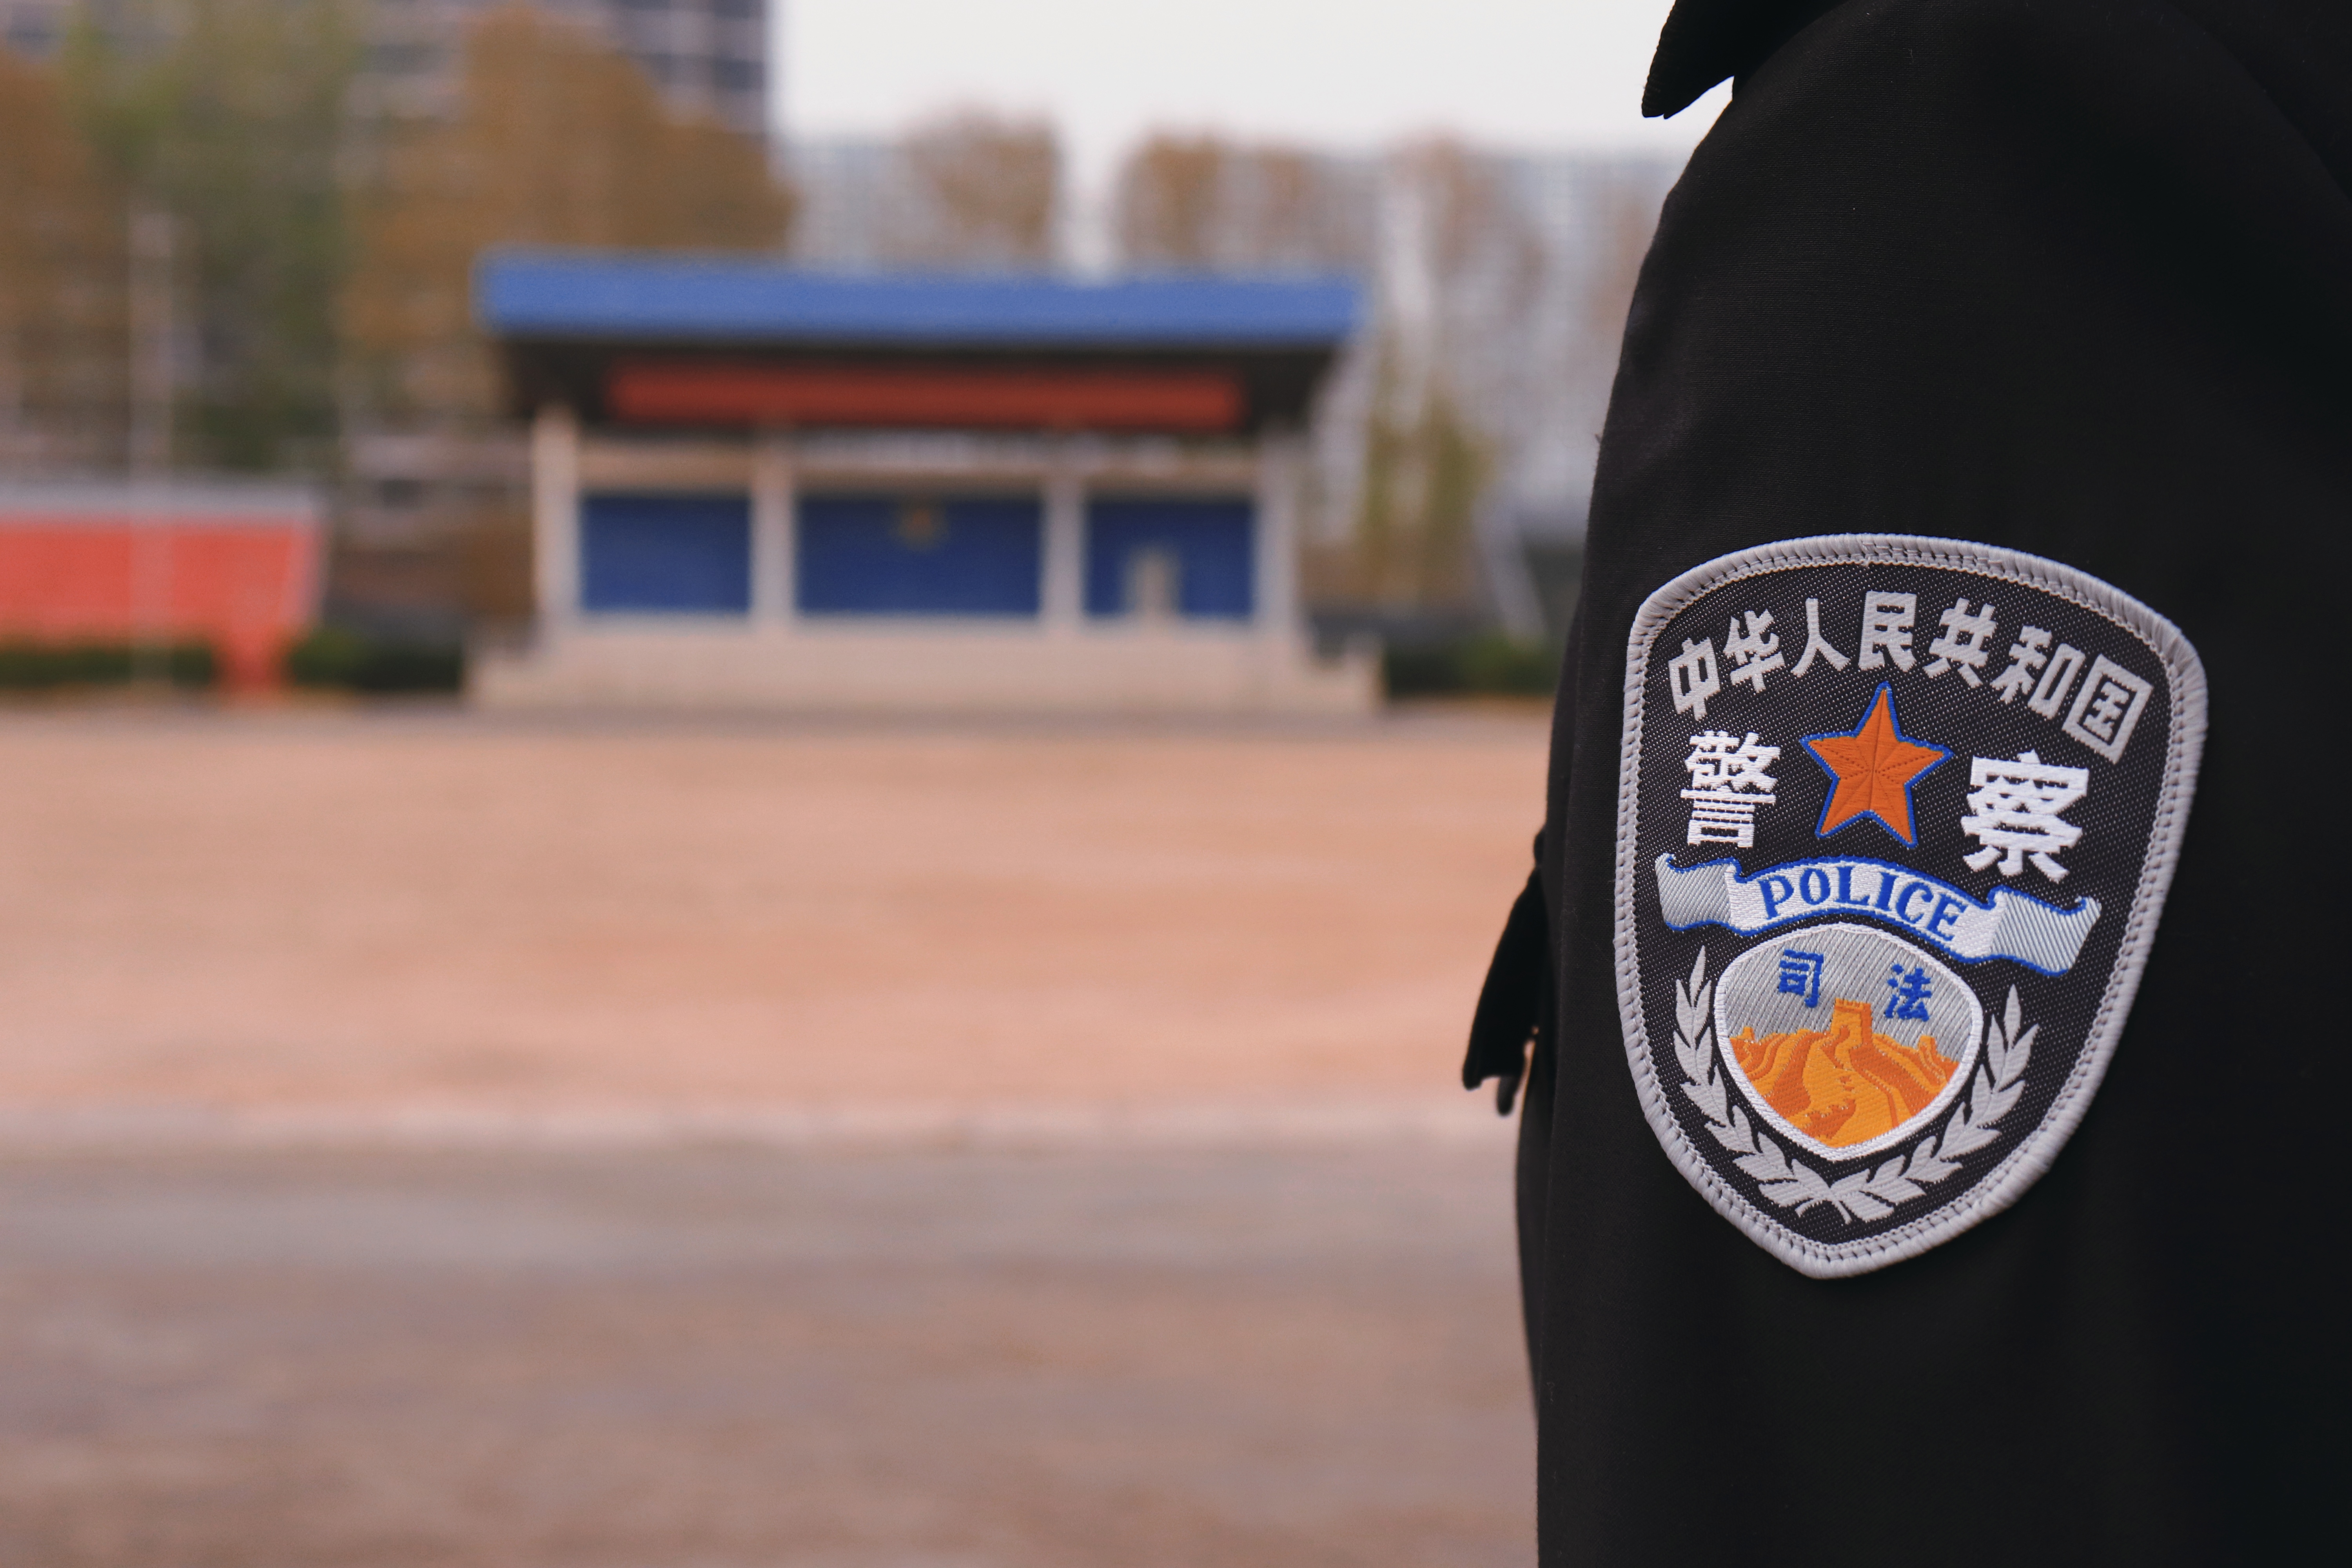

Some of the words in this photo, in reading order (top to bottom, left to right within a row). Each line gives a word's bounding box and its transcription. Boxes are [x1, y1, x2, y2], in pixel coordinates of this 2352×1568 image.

[1668, 590, 2154, 764] 中华人民共和国
[1758, 865, 1967, 943] POLICE
